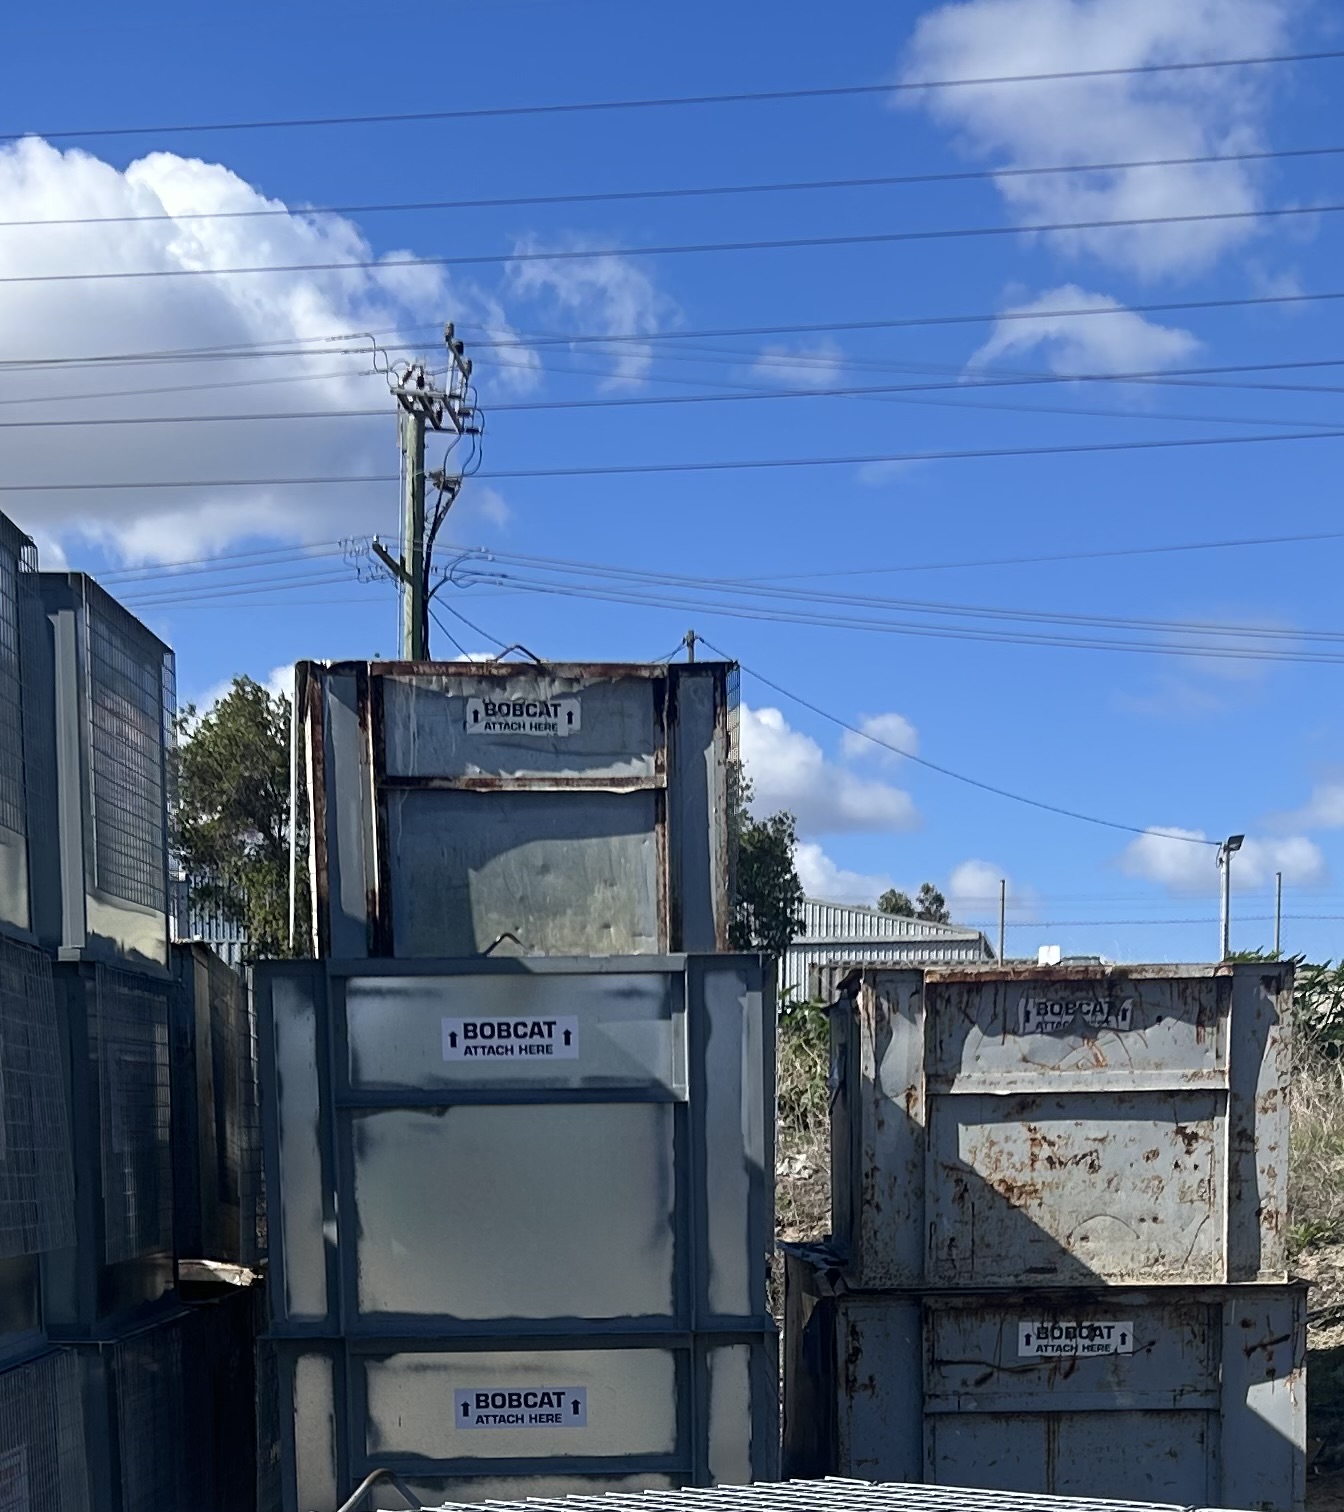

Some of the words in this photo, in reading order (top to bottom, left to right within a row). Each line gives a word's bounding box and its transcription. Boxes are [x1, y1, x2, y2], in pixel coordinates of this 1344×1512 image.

[484, 702, 561, 718] BOBCAT
[484, 722, 526, 732] ATTACH
[529, 722, 559, 732] HERE
[463, 1021, 557, 1040] BOBCAT
[464, 1044, 514, 1056] ATTACH
[518, 1043, 554, 1055] HERE
[1036, 1325, 1115, 1340] BOBCAT
[1036, 1343, 1078, 1353] ATTACH
[1082, 1343, 1111, 1353] HERE
[475, 1391, 566, 1409] BOBCAT
[475, 1414, 525, 1425] ATTACH
[529, 1413, 563, 1424] HERE
